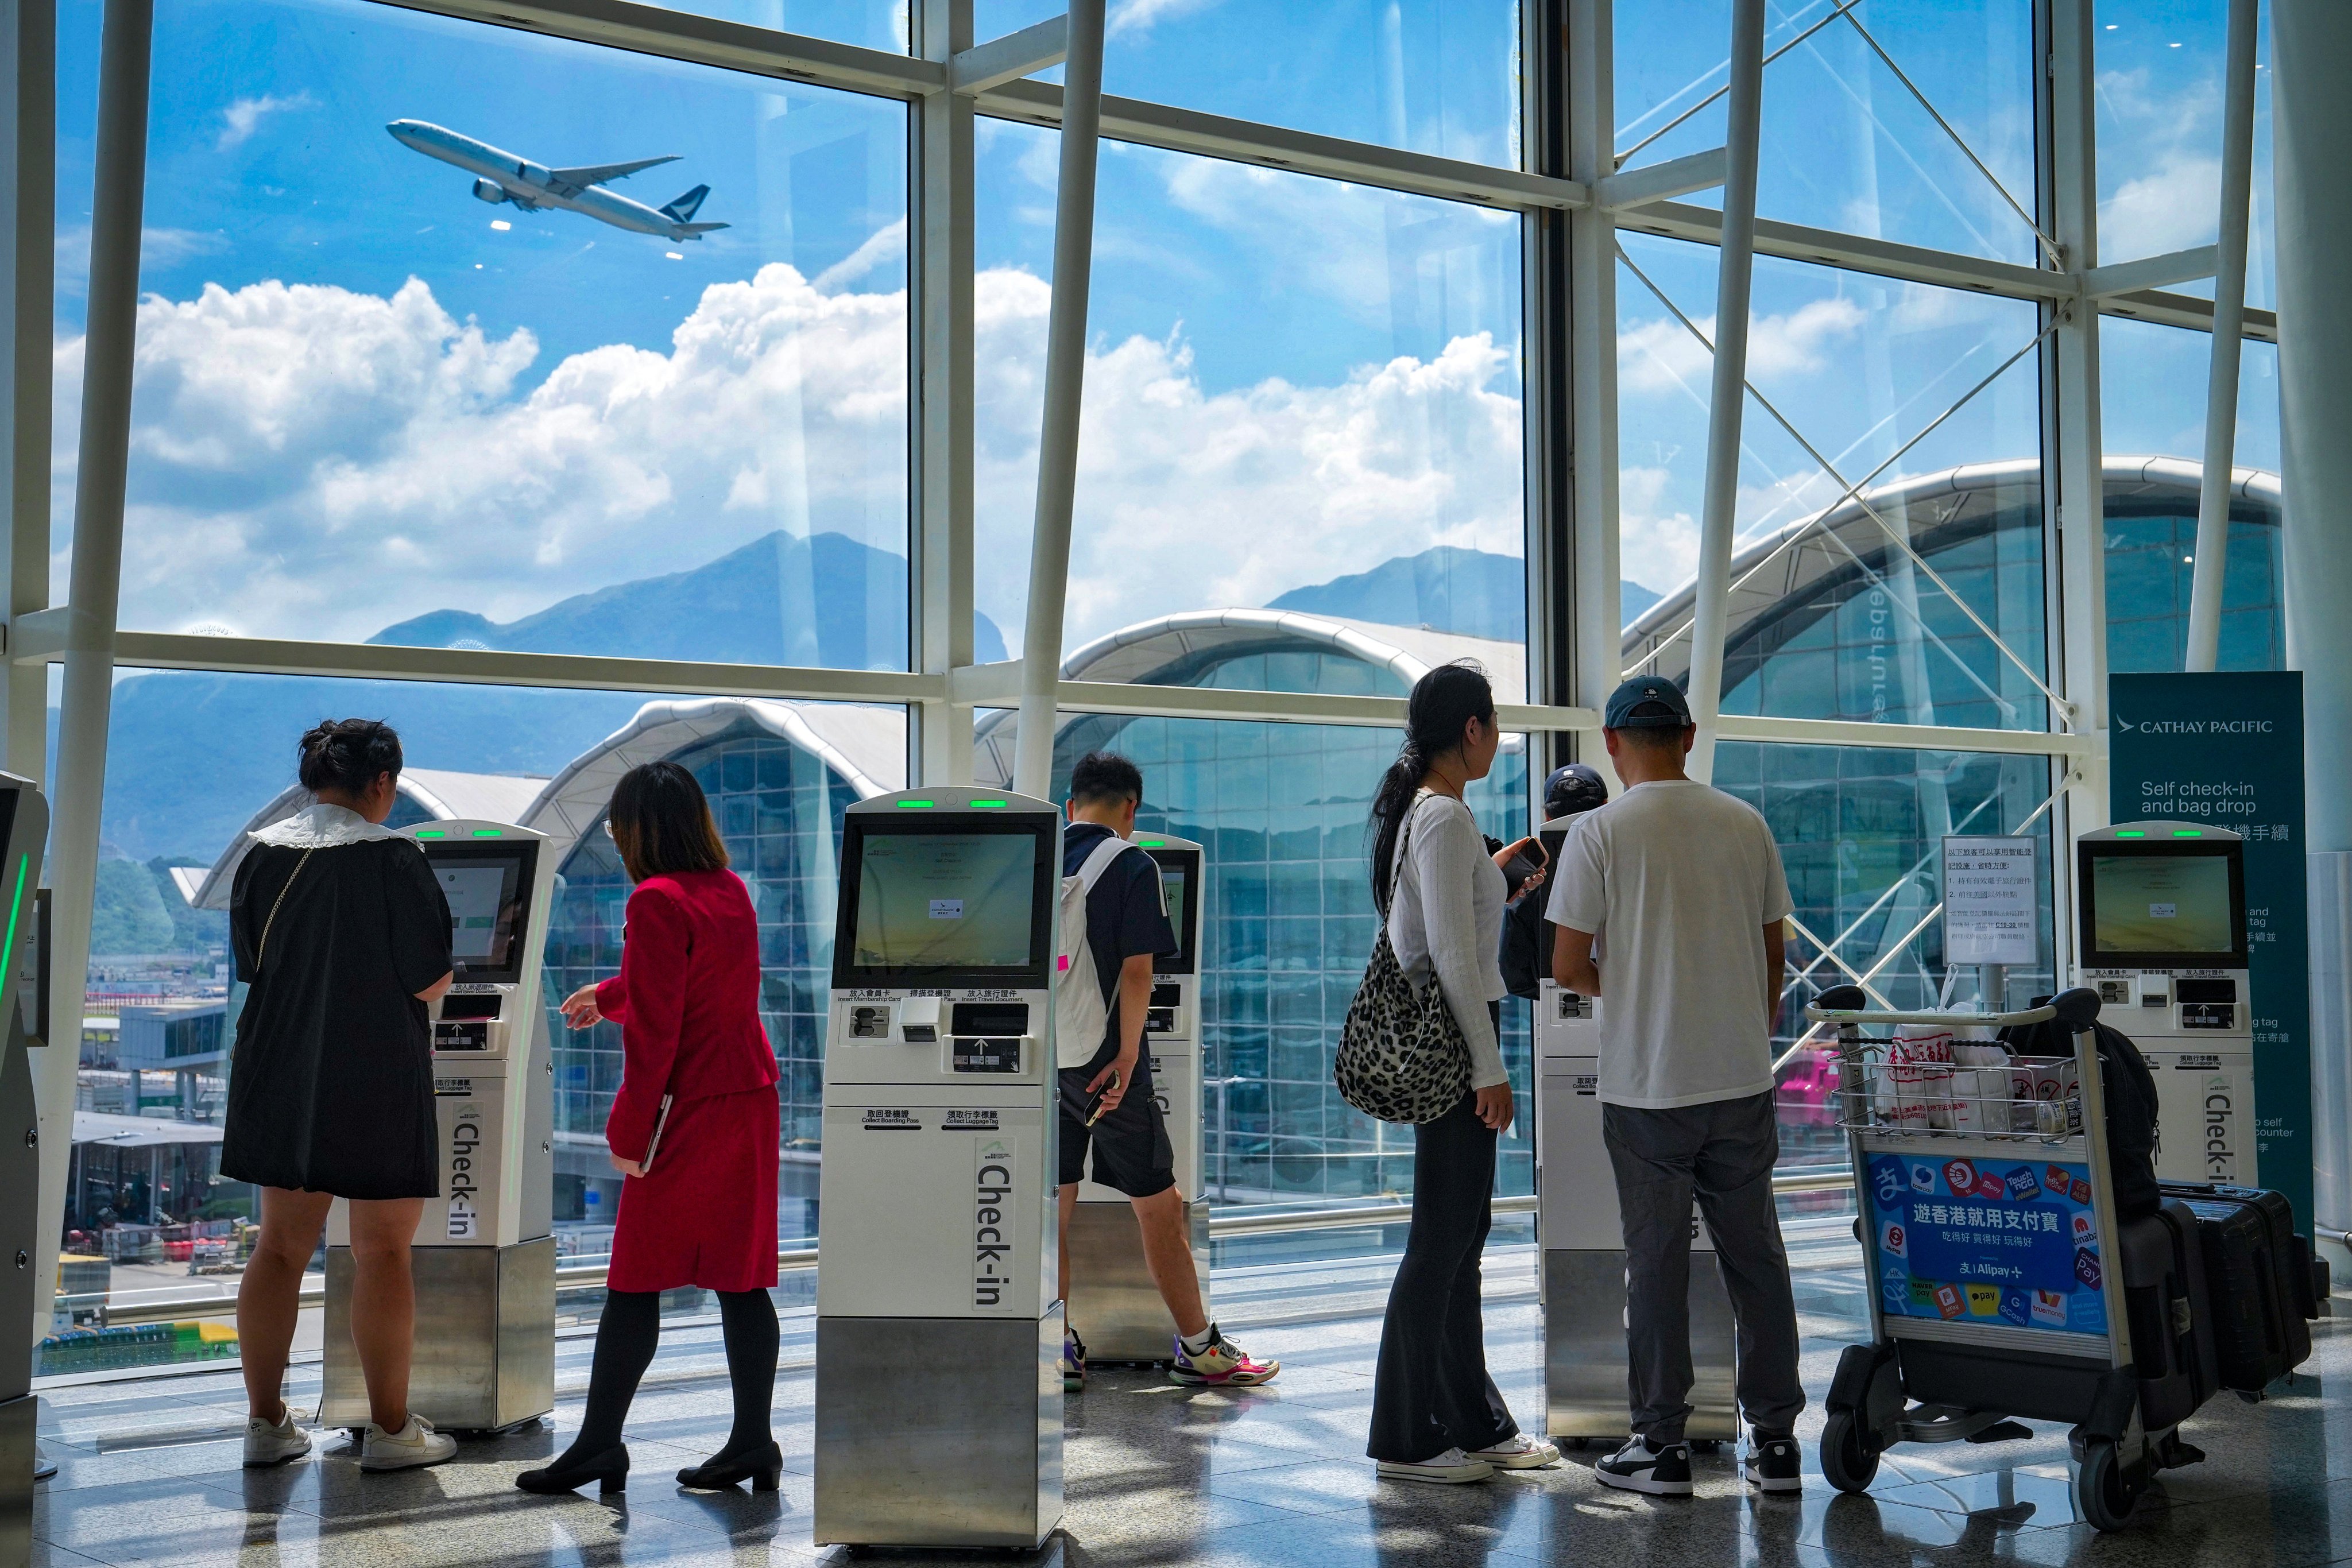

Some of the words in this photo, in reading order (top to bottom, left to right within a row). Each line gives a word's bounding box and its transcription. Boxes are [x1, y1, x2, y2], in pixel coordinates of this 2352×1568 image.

[2140, 721, 2206, 733] CATHAY
[2210, 721, 2272, 733] PACIFIC
[2141, 781, 2175, 796] Self
[2179, 781, 2254, 796] check-in
[2141, 799, 2173, 814] and
[2179, 799, 2210, 816] bag
[2216, 799, 2256, 816] drop
[2249, 907, 2268, 916] and
[2250, 917, 2266, 927] tag
[2261, 1017, 2278, 1028] tag
[867, 1109, 910, 1118] 取回登機證
[947, 1110, 998, 1119] 領取行李標籤
[2264, 1118, 2283, 1126] self
[2205, 1094, 2234, 1186] Check-i
[449, 1123, 479, 1234] Check-in
[2007, 1171, 2032, 1186] Touch
[2047, 1175, 2059, 1185] hello
[2045, 1180, 2067, 1194] money
[2016, 1187, 2040, 1202] eWallet
[1913, 1203, 2060, 1233] 遊香港就用支付寶
[976, 1165, 1012, 1305] Check-in
[1943, 1231, 1970, 1243] 吃得好
[1973, 1233, 2001, 1245] 買得好
[2004, 1236, 2033, 1247] 玩得好
[1886, 1245, 1901, 1255] MyPB
[2076, 1258, 2100, 1284] Pay
[1979, 1292, 1995, 1302] pay
[1945, 1304, 1959, 1313] MPay
[2000, 1305, 2025, 1325] GCash
